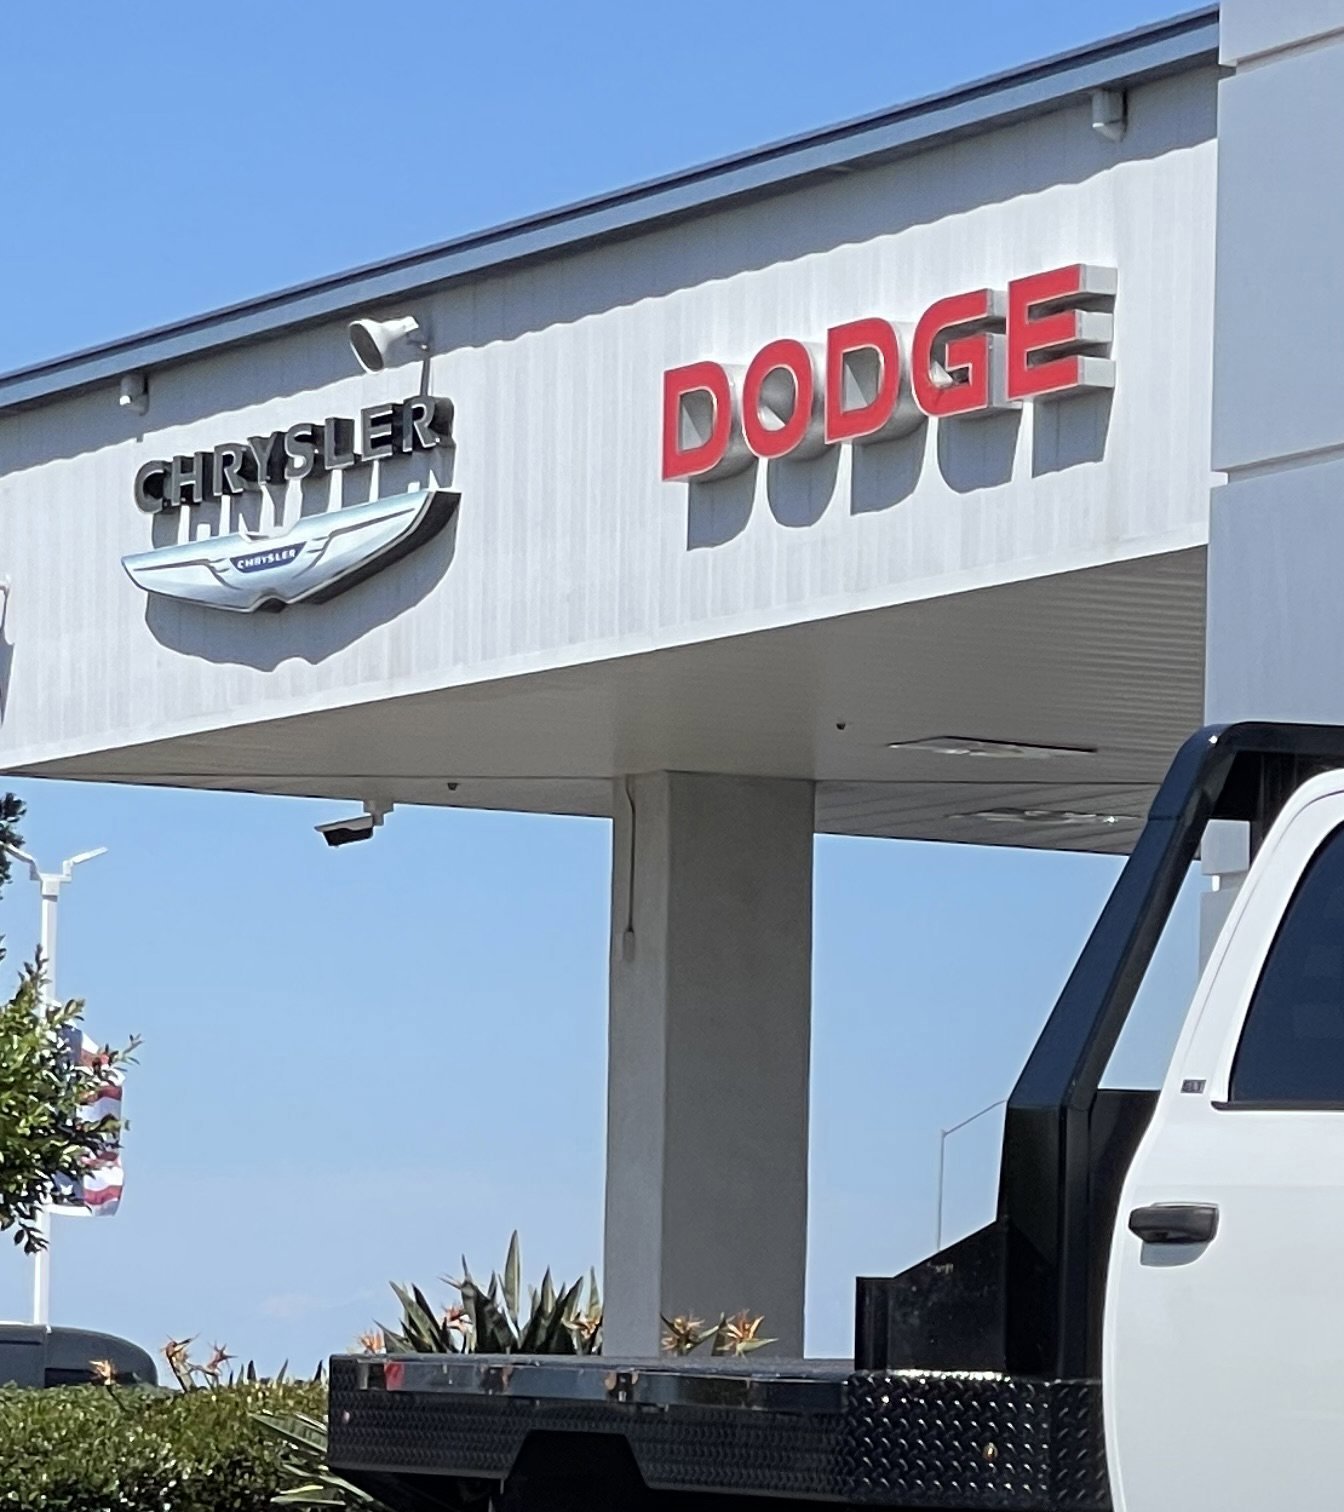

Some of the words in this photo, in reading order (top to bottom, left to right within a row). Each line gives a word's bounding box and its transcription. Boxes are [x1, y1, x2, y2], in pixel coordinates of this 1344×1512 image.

[662, 264, 1085, 482] DODGE
[134, 398, 446, 514] CHRYSLER
[237, 549, 296, 570] CHRYSLER
